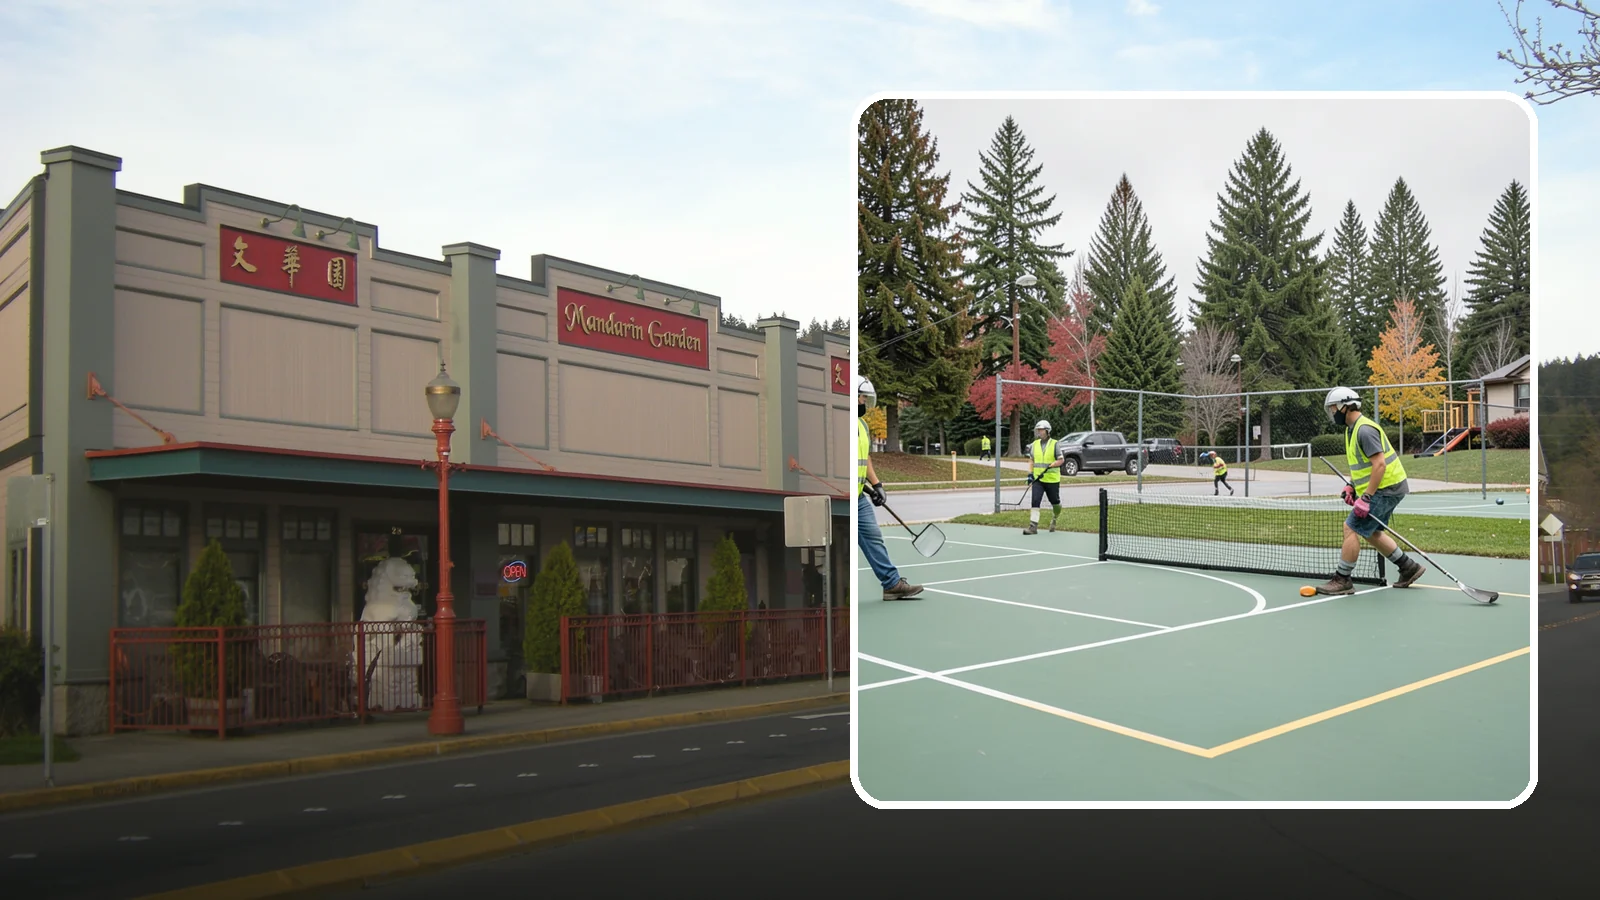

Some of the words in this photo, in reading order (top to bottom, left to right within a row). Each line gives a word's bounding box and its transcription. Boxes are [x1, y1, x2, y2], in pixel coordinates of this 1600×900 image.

[230, 235, 346, 291] 文華園
[564, 302, 644, 341] Mandarin
[648, 320, 702, 352] Garden
[503, 565, 527, 578] OPEN
